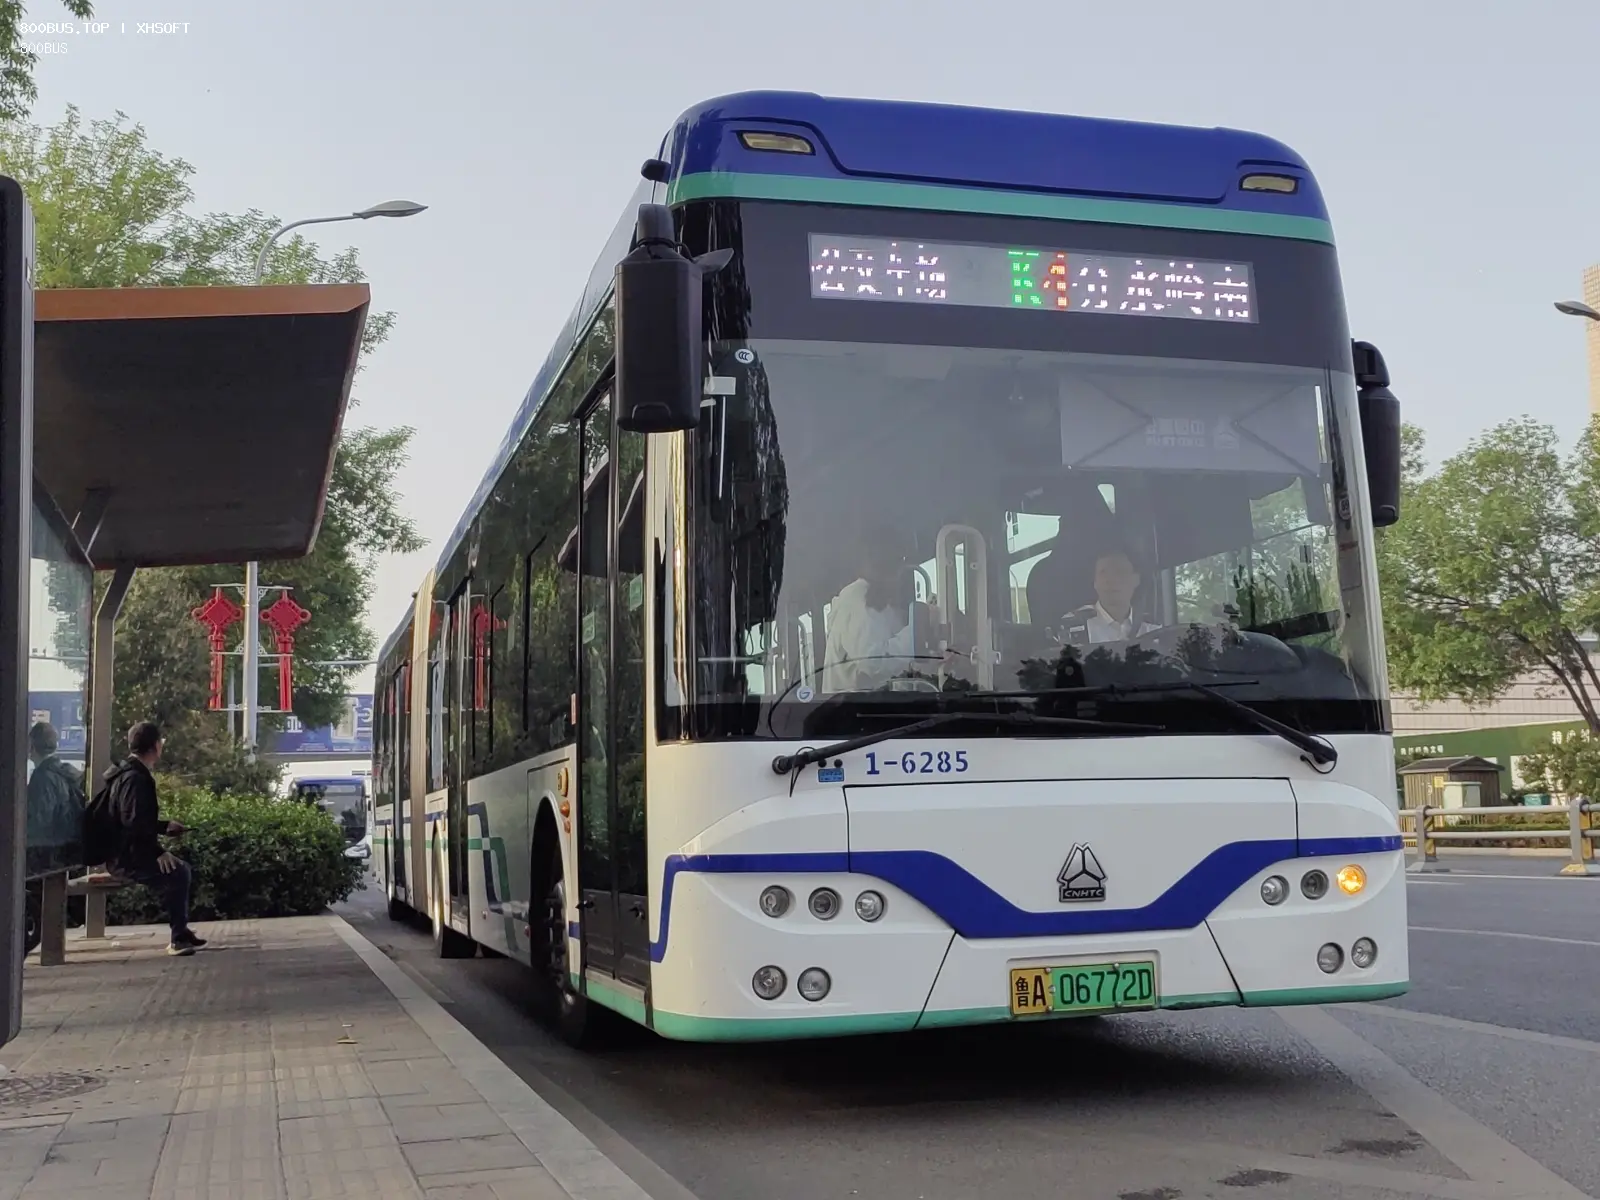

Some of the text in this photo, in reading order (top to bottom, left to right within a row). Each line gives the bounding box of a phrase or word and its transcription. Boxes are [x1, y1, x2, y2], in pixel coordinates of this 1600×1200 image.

[865, 750, 969, 775] 1-6285
[1064, 889, 1103, 898] CNHTC
[1059, 968, 1151, 1005] 06772D
